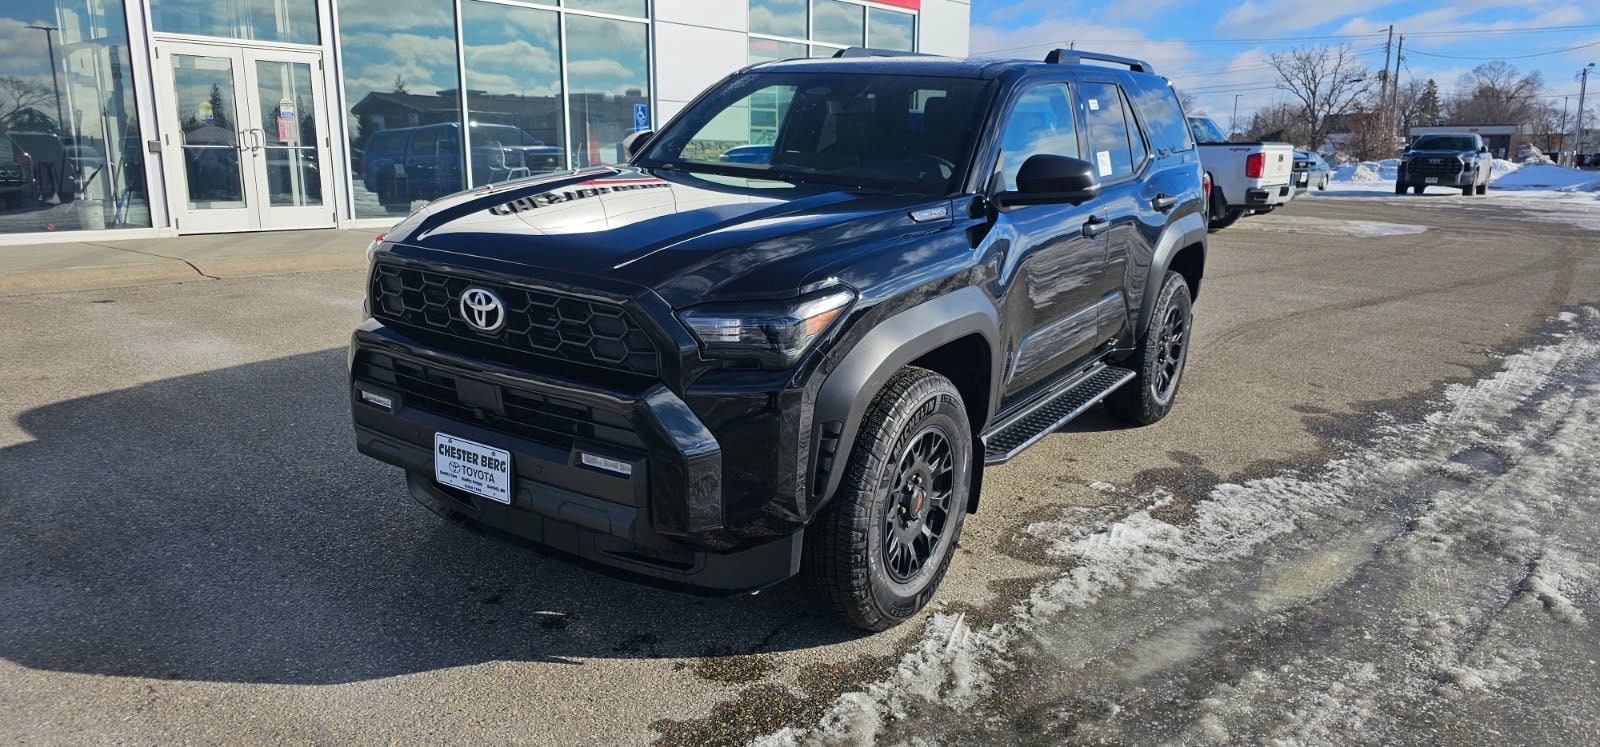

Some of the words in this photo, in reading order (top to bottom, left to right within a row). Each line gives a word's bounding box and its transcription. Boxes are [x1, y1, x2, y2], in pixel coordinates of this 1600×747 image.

[892, 397, 936, 463] MICHELIN
[439, 444, 478, 465] CHESTER
[481, 455, 506, 473] BERG
[461, 465, 495, 484] TOYOTA
